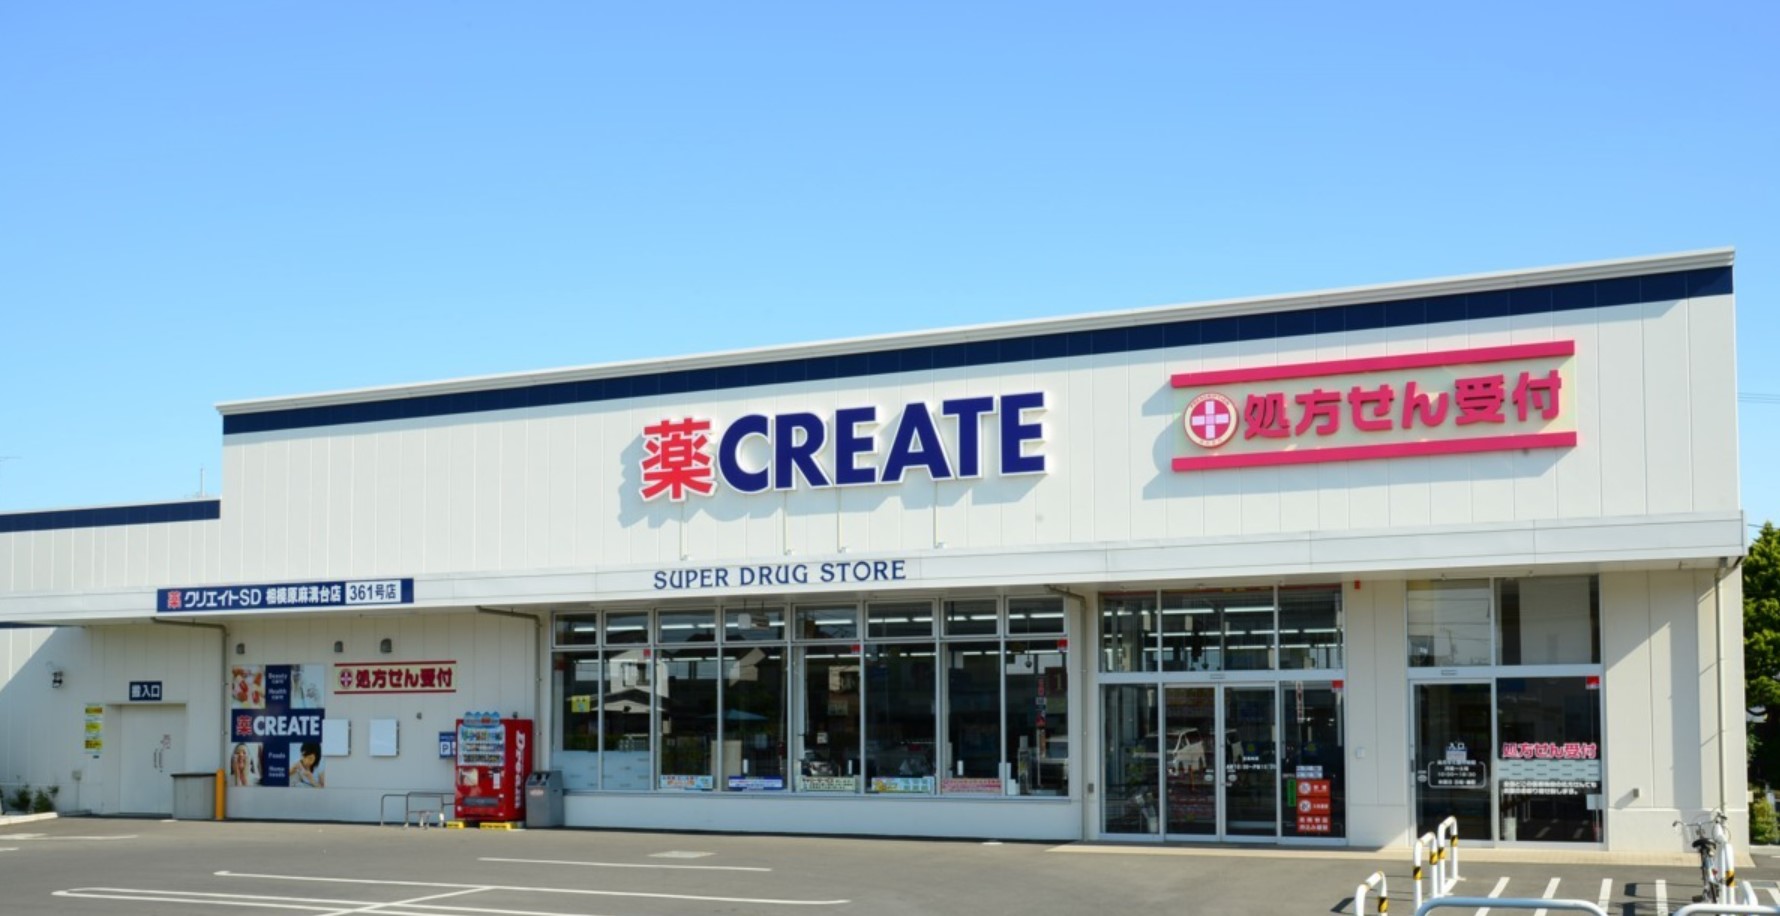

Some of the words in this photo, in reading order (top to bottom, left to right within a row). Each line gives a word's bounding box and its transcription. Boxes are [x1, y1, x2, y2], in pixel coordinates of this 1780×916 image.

[1244, 369, 1562, 440] 処方せん受付
[653, 568, 729, 590] SUPER
[740, 564, 808, 586] DRUG
[820, 560, 906, 583] STORE
[349, 583, 397, 601] 361号店
[355, 667, 453, 689] 処方せん受付
[1502, 741, 1597, 759] 処方せん受付
